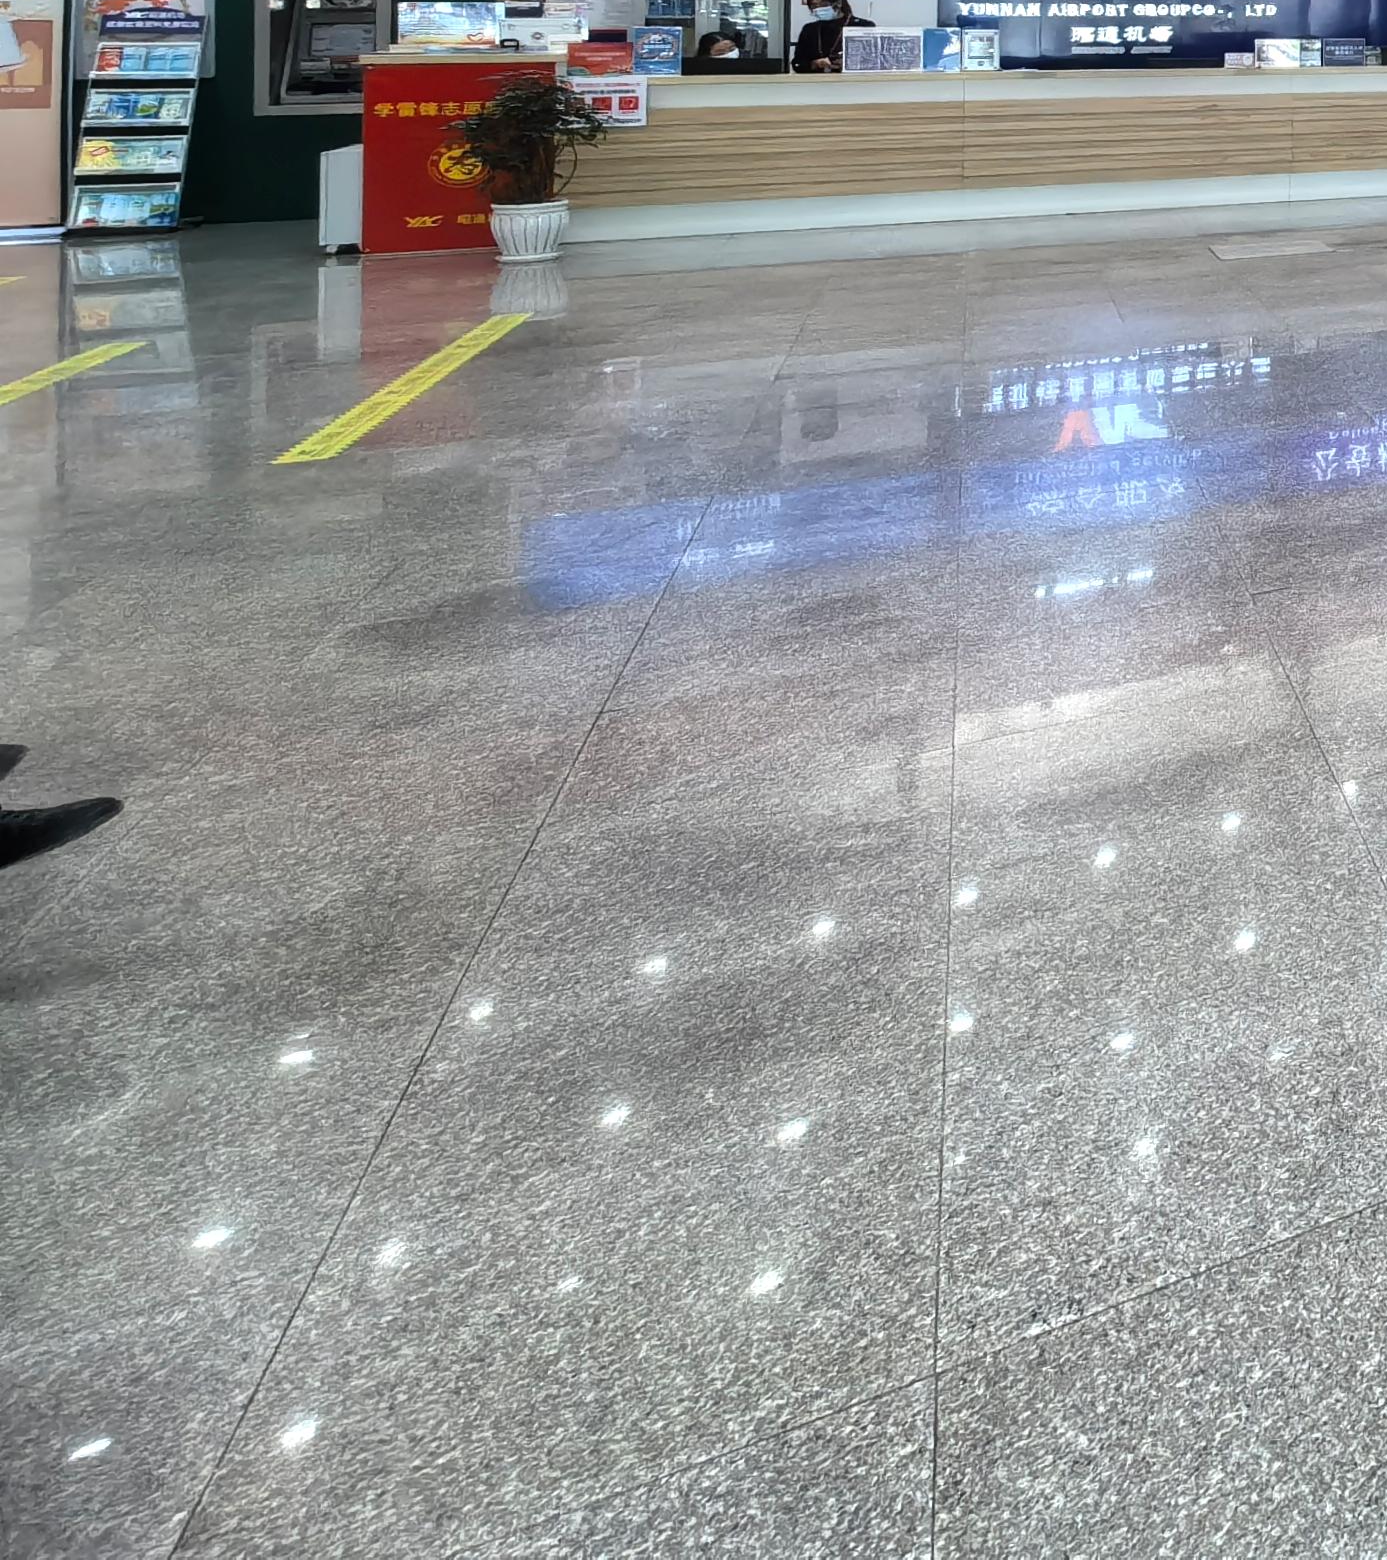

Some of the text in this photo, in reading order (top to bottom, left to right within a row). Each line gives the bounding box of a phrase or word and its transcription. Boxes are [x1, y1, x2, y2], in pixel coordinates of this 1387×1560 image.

[956, 1, 1041, 18] YUNNAN
[1048, 2, 1129, 18] AIRPORT
[1245, 3, 1278, 18] LTD
